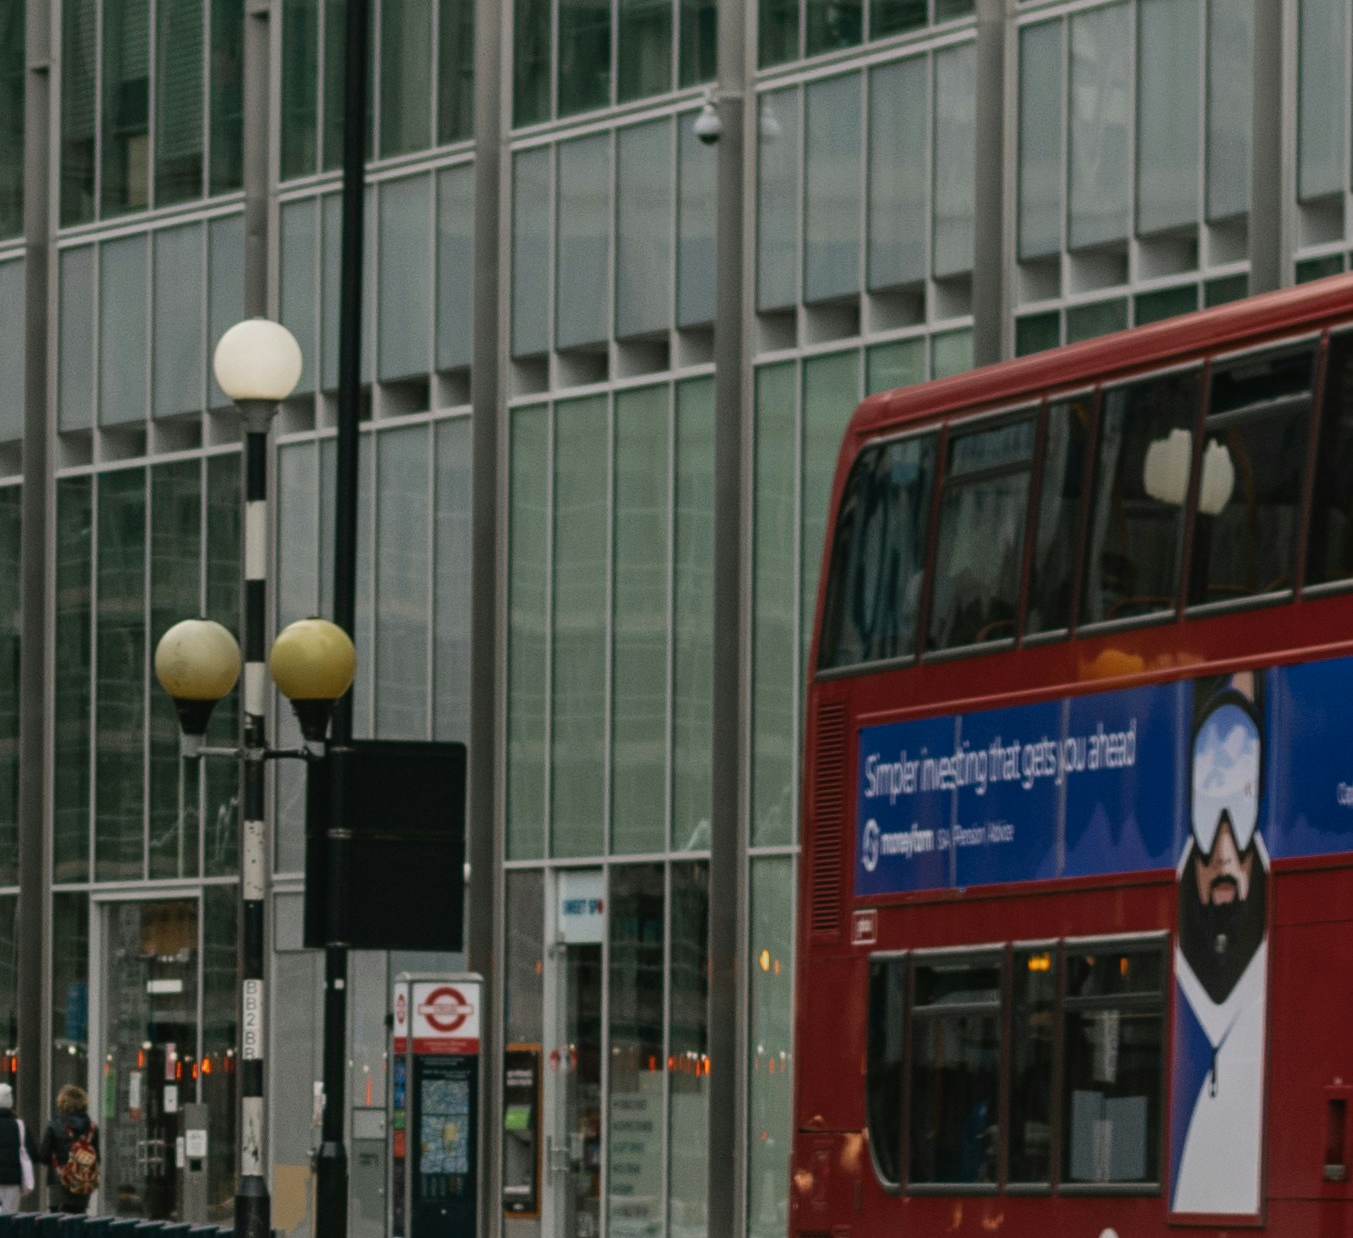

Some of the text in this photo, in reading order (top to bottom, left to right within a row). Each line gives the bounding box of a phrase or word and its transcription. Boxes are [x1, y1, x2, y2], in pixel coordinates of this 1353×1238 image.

[864, 718, 1137, 805] Simpler investing that gets you ahead
